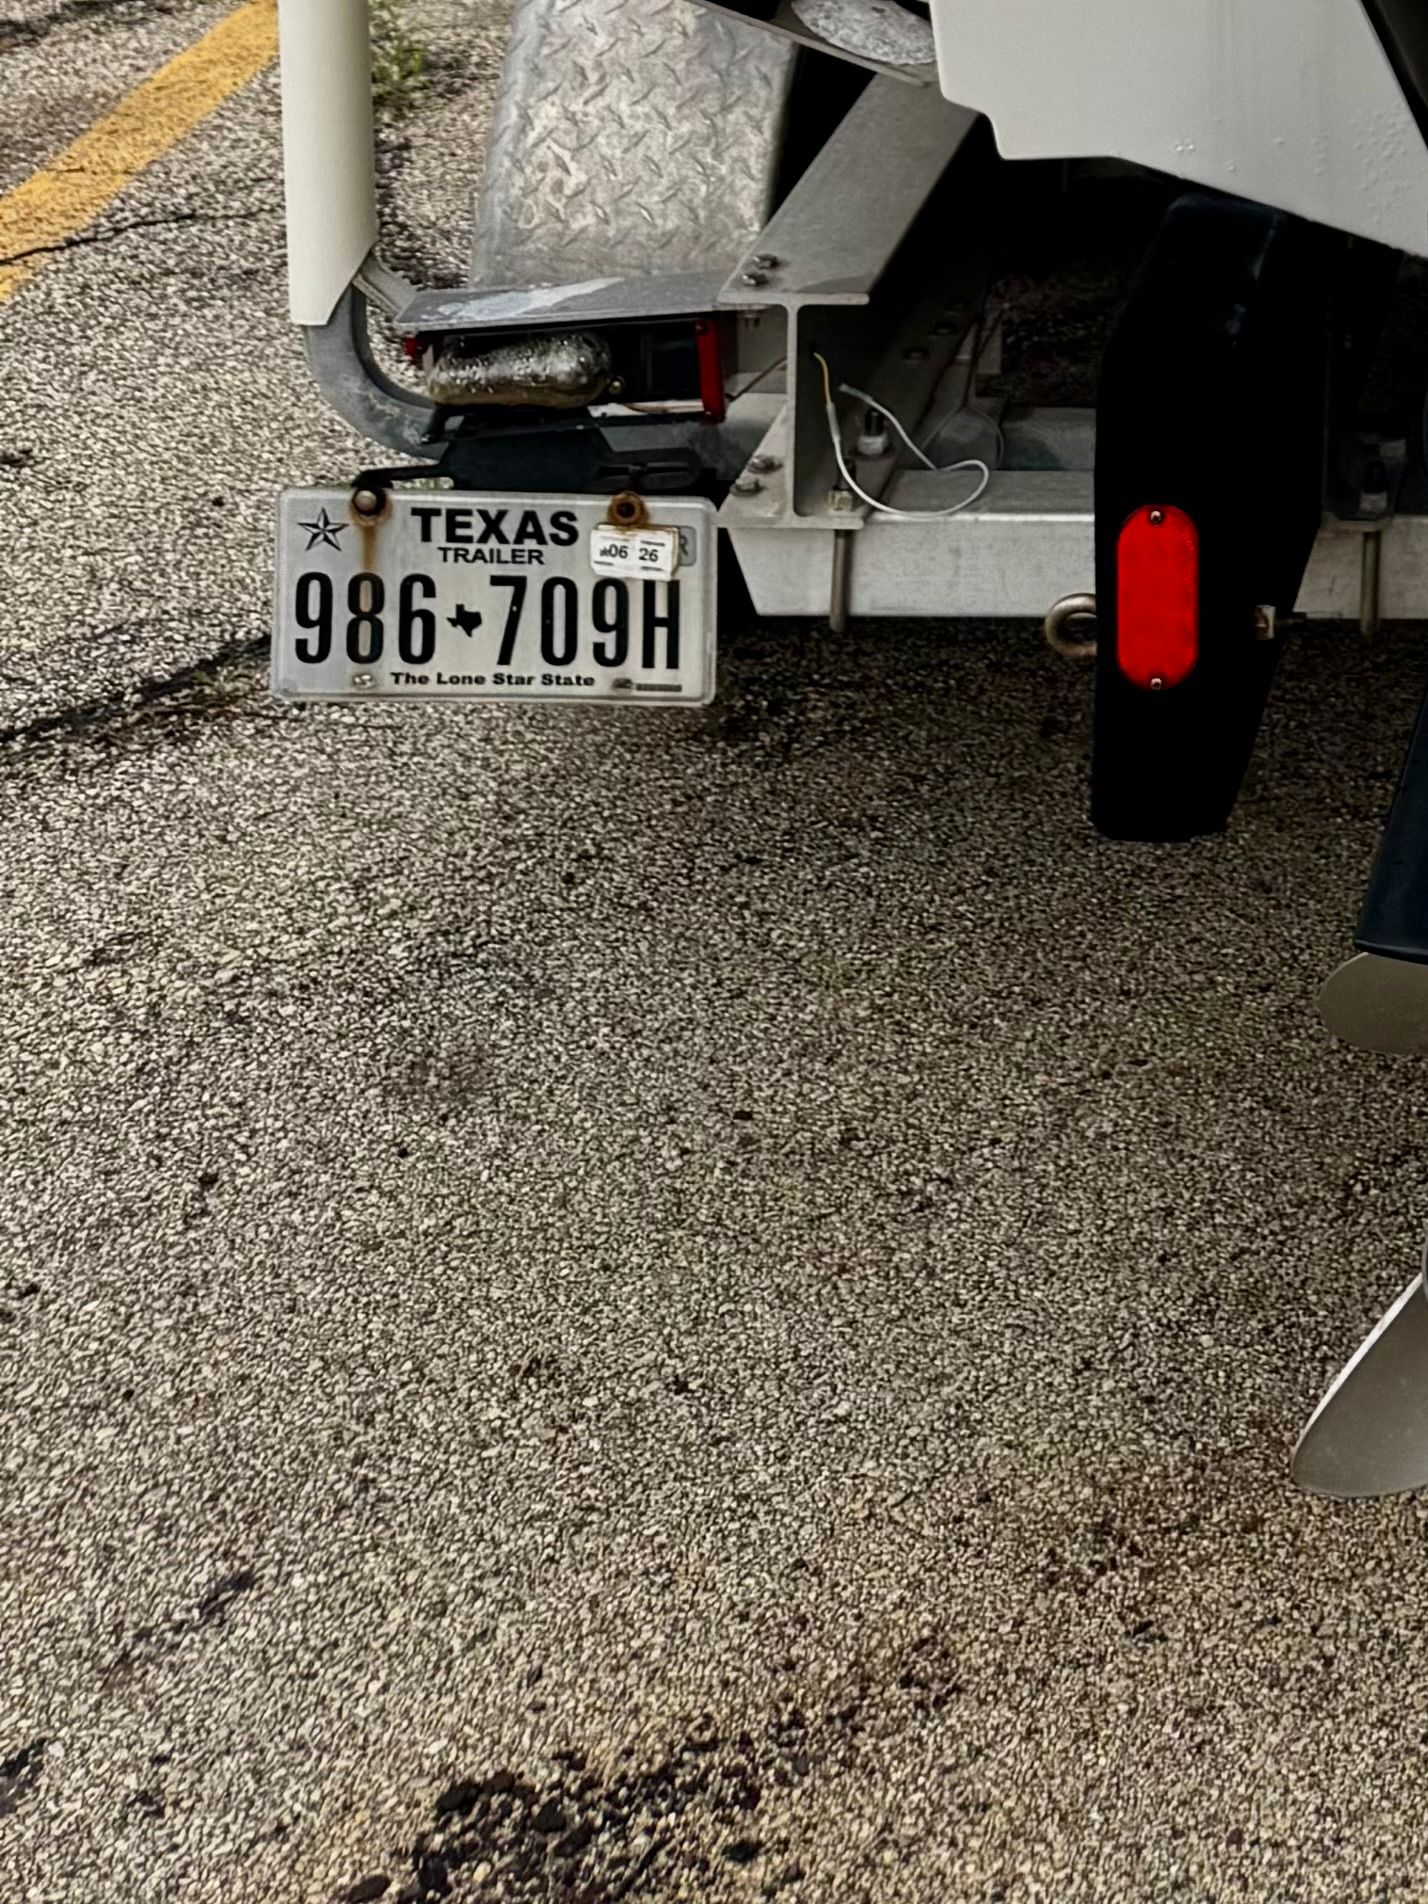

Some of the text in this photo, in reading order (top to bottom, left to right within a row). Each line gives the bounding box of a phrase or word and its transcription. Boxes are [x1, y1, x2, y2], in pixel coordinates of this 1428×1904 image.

[411, 507, 579, 546] TEXAS
[438, 547, 545, 566] TRAILER
[609, 543, 629, 559] 06
[638, 547, 659, 562] 26
[390, 671, 430, 685] The
[436, 672, 486, 686] Lone
[492, 672, 535, 686] Star
[541, 673, 596, 687] State
